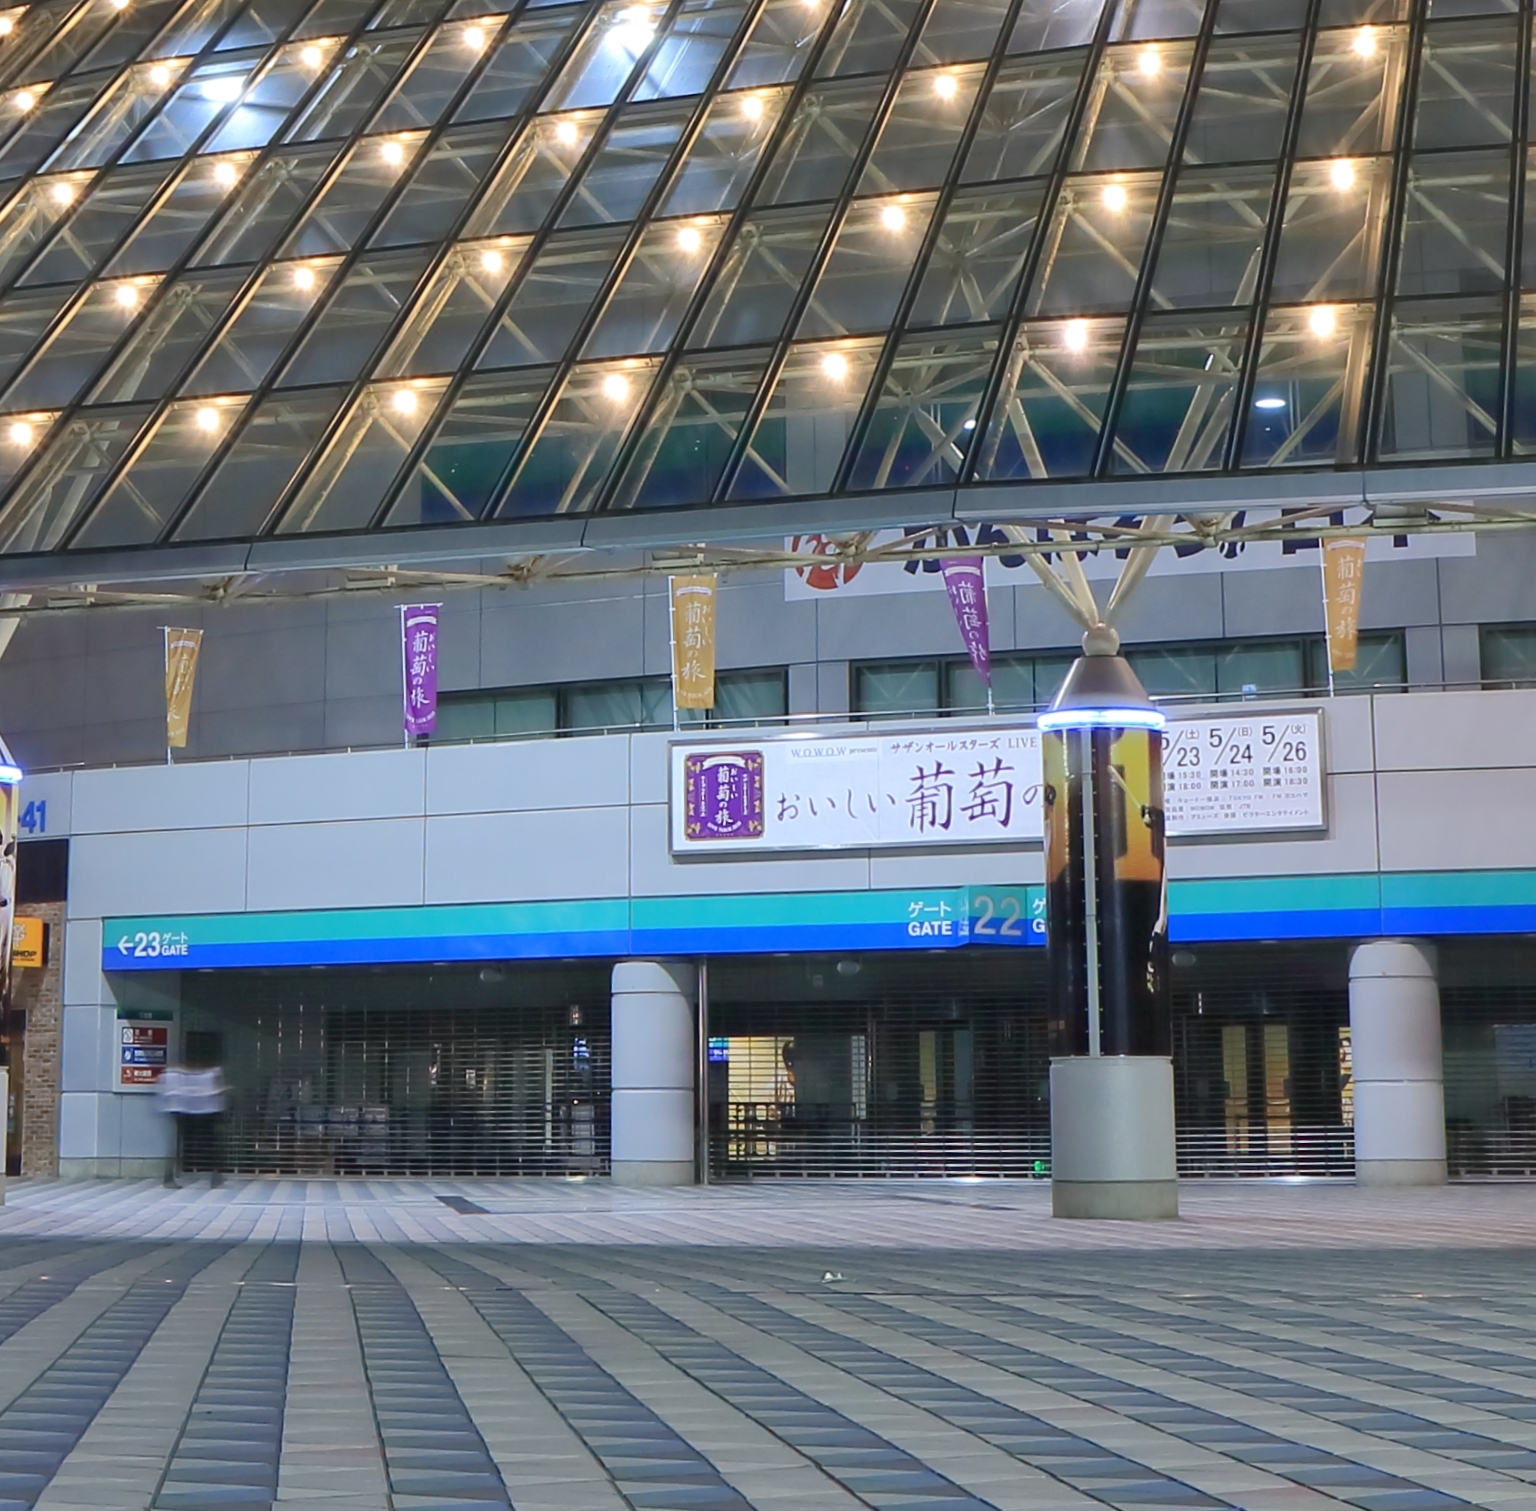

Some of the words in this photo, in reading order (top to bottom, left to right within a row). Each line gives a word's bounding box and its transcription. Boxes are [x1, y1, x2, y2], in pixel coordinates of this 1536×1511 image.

[681, 601, 706, 682] 葡萄の旅
[890, 738, 999, 754] サザンオールスターズ
[1007, 737, 1037, 749] LIVE
[1163, 772, 1175, 780] 場
[715, 765, 734, 826] 葡萄の旅
[1163, 783, 1176, 791] 演
[907, 901, 952, 918] ゲート
[973, 894, 1022, 936] 22
[907, 921, 953, 936] GATE
[133, 932, 161, 957] 23
[162, 931, 189, 944] ゲート
[161, 945, 189, 956] GATE
